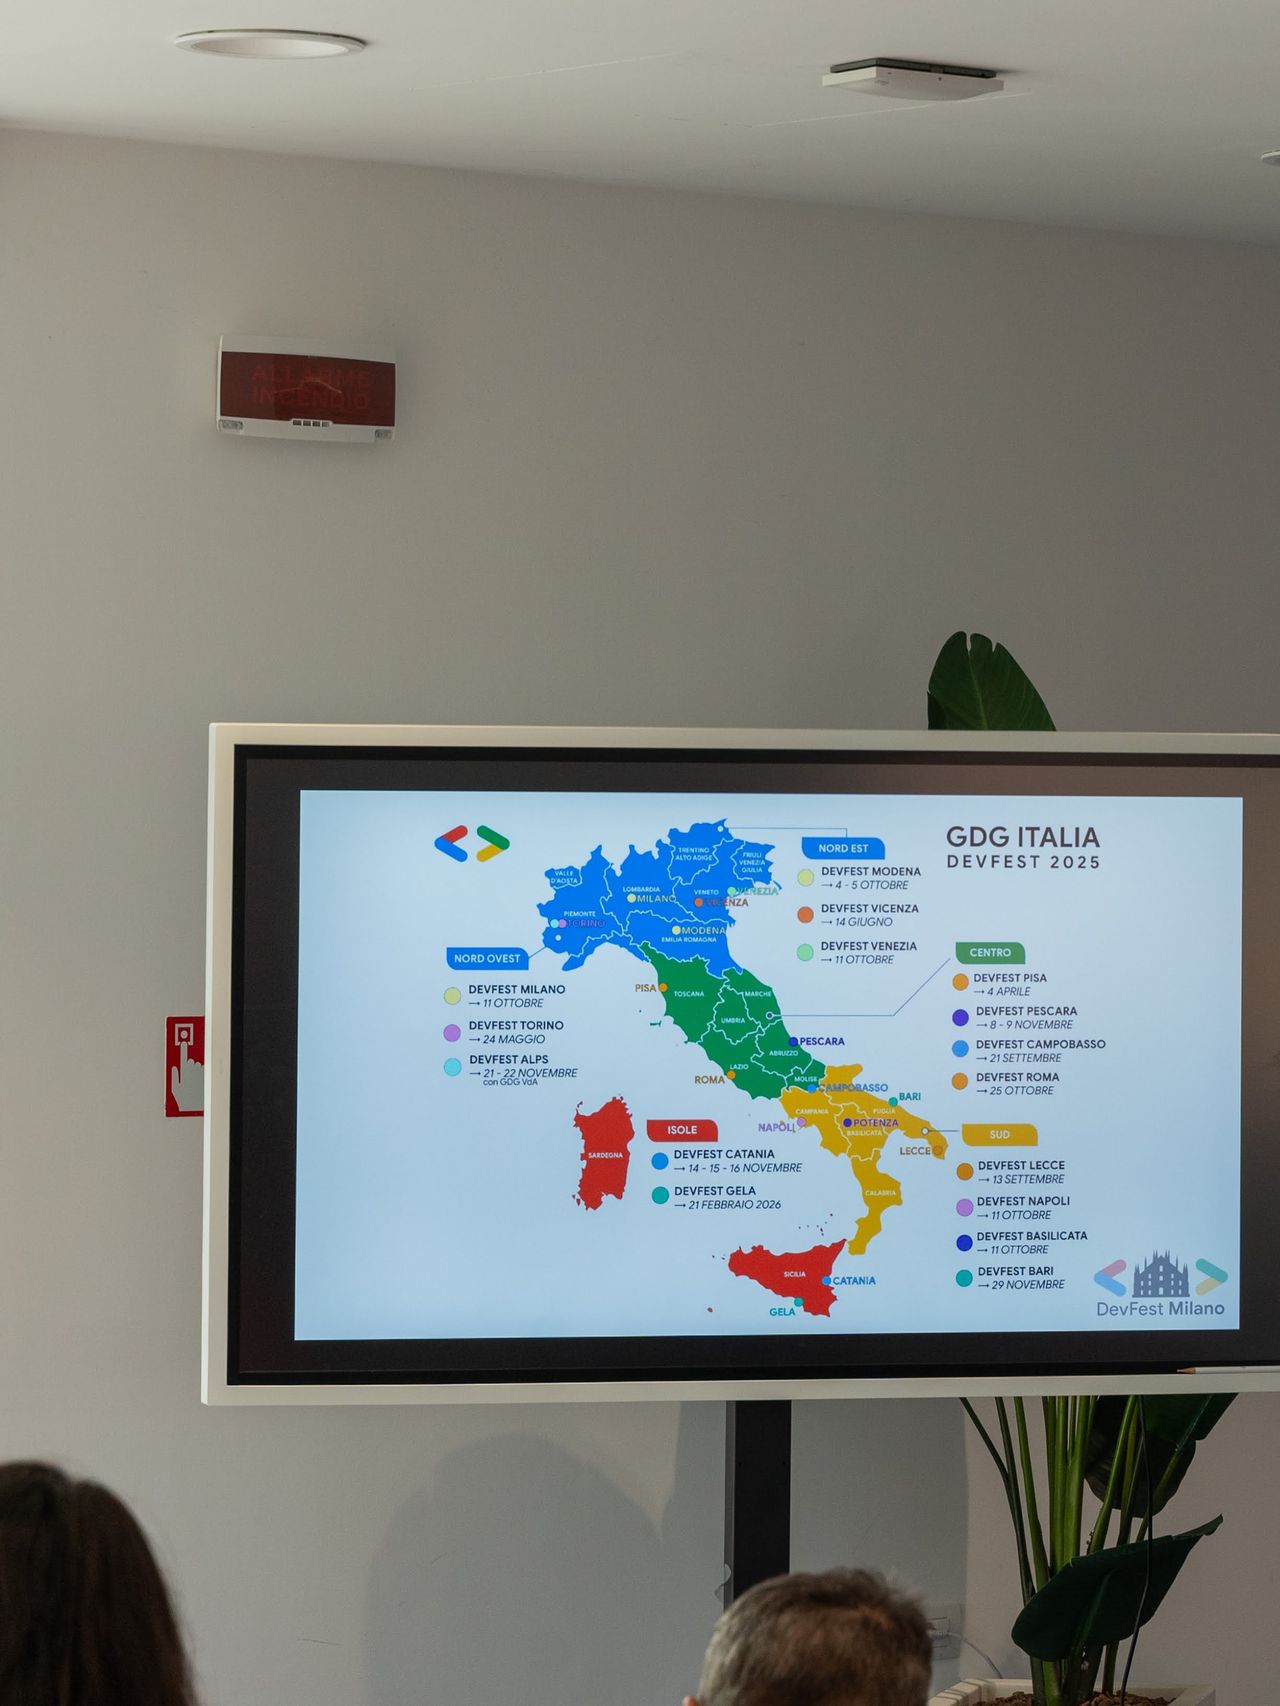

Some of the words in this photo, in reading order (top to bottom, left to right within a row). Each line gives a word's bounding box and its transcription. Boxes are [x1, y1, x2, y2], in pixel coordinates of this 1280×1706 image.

[947, 826, 1009, 848] GDG
[1018, 827, 1100, 848] ITALIA
[819, 844, 848, 853] NORD
[852, 844, 868, 852] EST
[948, 855, 1040, 868] DEVFEST
[1051, 856, 1099, 868] 2025
[822, 867, 869, 876] DEVFEST
[872, 867, 921, 877] MODENA
[835, 881, 842, 889] 4
[851, 881, 858, 889] 5
[860, 880, 909, 890] OTTOBRE
[737, 887, 779, 896] VENEZIA
[637, 894, 677, 902] MILANO
[822, 905, 869, 913] DEVFEST
[871, 904, 919, 913] VICENZA
[835, 918, 846, 926] 14
[848, 917, 893, 927] GIUGNO
[681, 926, 726, 934] MODENA
[821, 942, 869, 951] DEVFEST
[871, 942, 918, 951] VENEZIA
[970, 948, 1012, 958] CENTRO
[454, 954, 485, 964] NORD
[487, 954, 520, 964] OVEST
[835, 955, 844, 964] 11
[845, 955, 894, 965] OTTOBRE
[974, 974, 1020, 983] DEVFEST
[1023, 973, 1047, 983] PISA
[469, 985, 518, 994] DEVFEST
[520, 984, 566, 995] MILANO
[635, 984, 657, 992] PISA
[988, 987, 994, 996] 4
[996, 987, 1031, 996] APRILE
[483, 999, 492, 1008] 11
[493, 998, 543, 1008] OTTOBRE
[976, 1007, 1024, 1016] DEVFEST
[1027, 1007, 1078, 1016] PESCARA
[469, 1021, 518, 1030] DEVFEST
[520, 1021, 564, 1031] TORINO
[990, 1021, 997, 1029] 8
[1006, 1020, 1012, 1029] 9
[1014, 1020, 1073, 1030] NOVEMBRE
[483, 1035, 496, 1044] 24
[498, 1034, 546, 1044] MAGGIO
[800, 1037, 845, 1046] PESCARA
[976, 1040, 1024, 1049] DEVFEST
[1027, 1039, 1106, 1049] CAMPOBASSO
[470, 1055, 517, 1064] DEVFEST
[521, 1054, 549, 1064] ALPS
[990, 1054, 1000, 1062] 21
[1002, 1053, 1062, 1063] SETTEMBRE
[484, 1069, 494, 1077] 21
[504, 1069, 516, 1078] 22
[518, 1068, 578, 1078] NOVEMBRE
[976, 1073, 1024, 1082] DEVFEST
[1027, 1072, 1060, 1082] ROMA
[500, 1078, 520, 1086] GDG
[695, 1076, 725, 1084] ROMA
[818, 1083, 888, 1092] CAMPOBASSO
[990, 1086, 1002, 1095] 25
[1004, 1086, 1054, 1096] OTTOBRE
[899, 1092, 921, 1101] BARI
[853, 1119, 899, 1127] POTENZA
[668, 1126, 697, 1134] ISOLE
[990, 1130, 1010, 1139] SUD
[674, 1150, 723, 1159] DEVFEST
[726, 1150, 775, 1159] CATANIA
[900, 1147, 931, 1156] LECCE
[688, 1164, 699, 1173] 14
[709, 1164, 720, 1173] 15
[729, 1164, 740, 1173] 16
[742, 1163, 802, 1173] NOVEMBRE
[978, 1161, 1026, 1170] DEVFEST
[1029, 1161, 1065, 1170] LECCE
[992, 1175, 1003, 1184] 13
[1005, 1174, 1065, 1184] SETTEMBRE
[674, 1187, 723, 1196] DEVFEST
[726, 1186, 756, 1196] GELA
[688, 1201, 699, 1209] 21
[701, 1200, 754, 1210] FEBBRAIO
[757, 1200, 782, 1209] 2026
[977, 1197, 1026, 1206] DEVFEST
[1028, 1197, 1070, 1206] NAPOLI
[991, 1211, 999, 1220] 11
[1001, 1210, 1052, 1220] OTTOBRE
[977, 1232, 1024, 1241] DEVFEST
[1027, 1231, 1088, 1241] BASILICATA
[991, 1246, 999, 1254] 11
[1001, 1245, 1048, 1254] OTTOBRE
[978, 1267, 1026, 1276] DEVFEST
[1029, 1267, 1053, 1276] BARI
[833, 1277, 876, 1285] CATANIA
[992, 1281, 1004, 1289] 29
[1006, 1279, 1065, 1289] NOVEMBRE
[769, 1308, 796, 1317] GELA
[1097, 1302, 1164, 1316] DevFest
[1168, 1302, 1225, 1316] Milano
